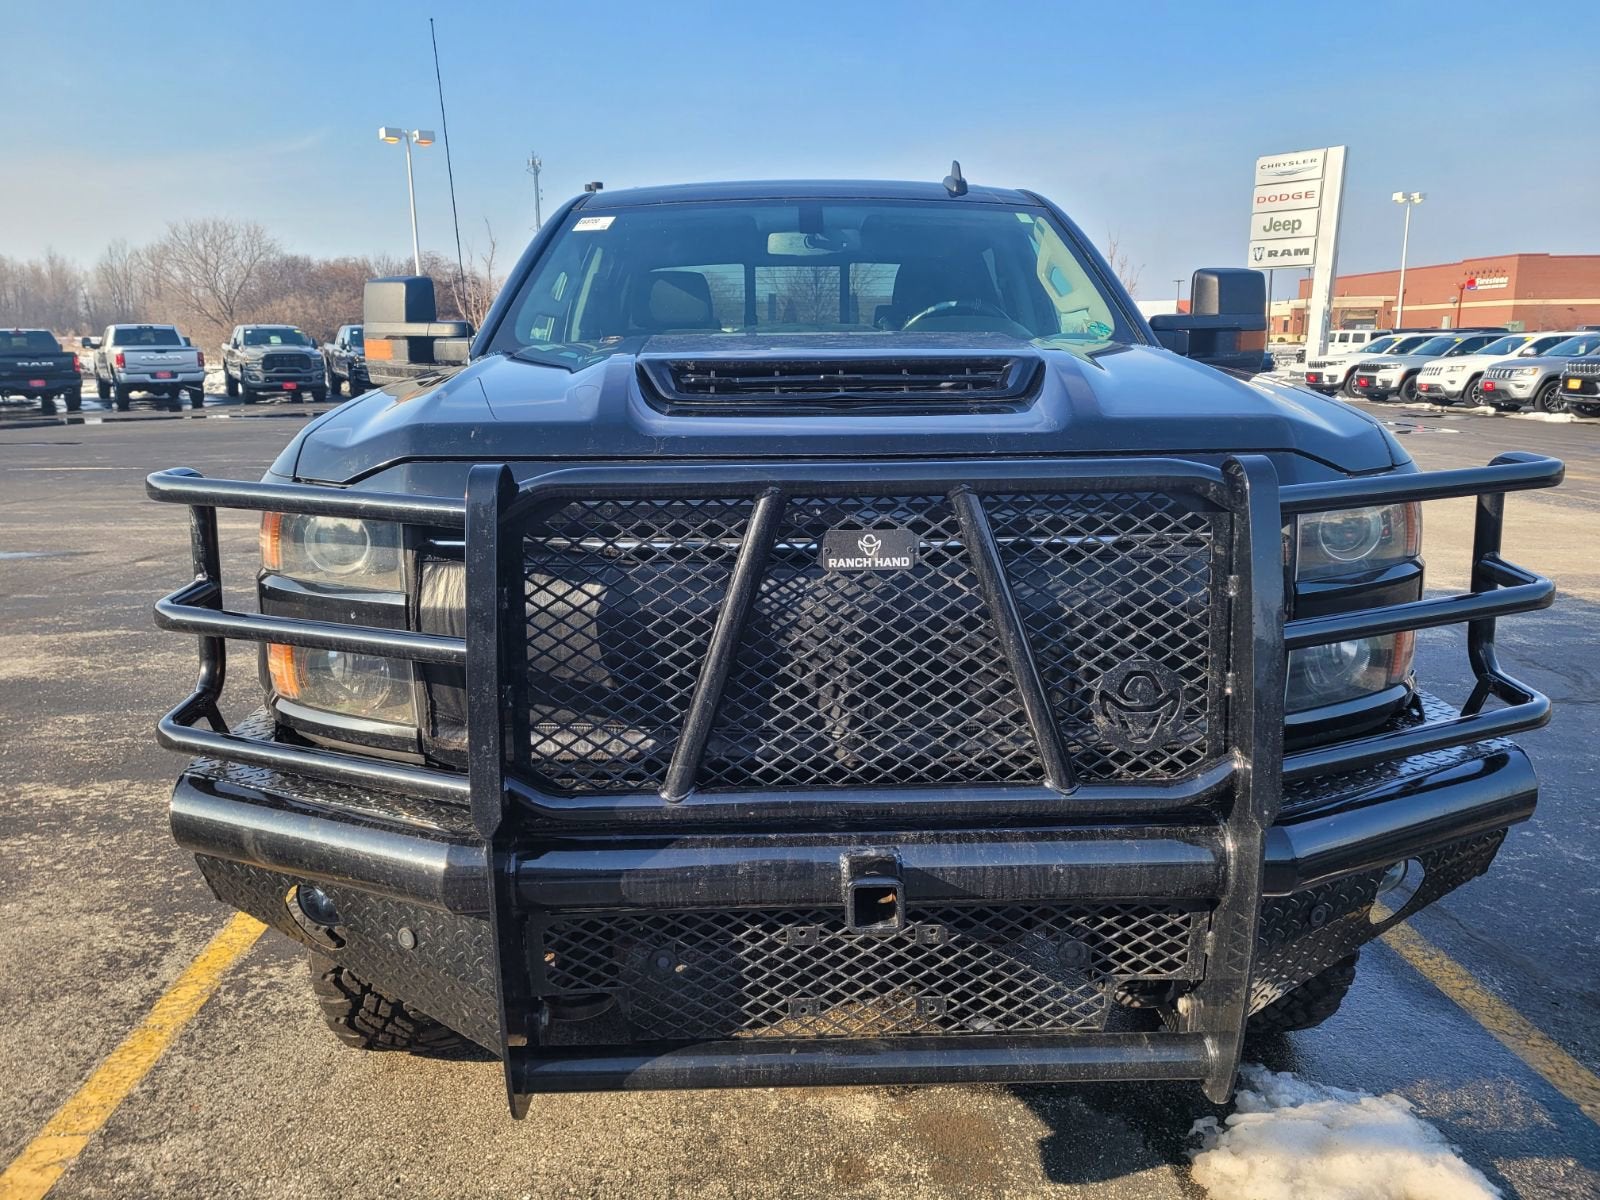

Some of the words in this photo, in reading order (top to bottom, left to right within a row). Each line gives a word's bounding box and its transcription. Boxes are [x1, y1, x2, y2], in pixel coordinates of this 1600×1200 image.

[1260, 158, 1318, 170] CHRYSLER
[1256, 190, 1316, 204] DODGE
[1262, 217, 1302, 234] Jeep
[1267, 247, 1310, 257] RAM
[828, 558, 872, 568] RANCH
[874, 557, 910, 567] HAND
